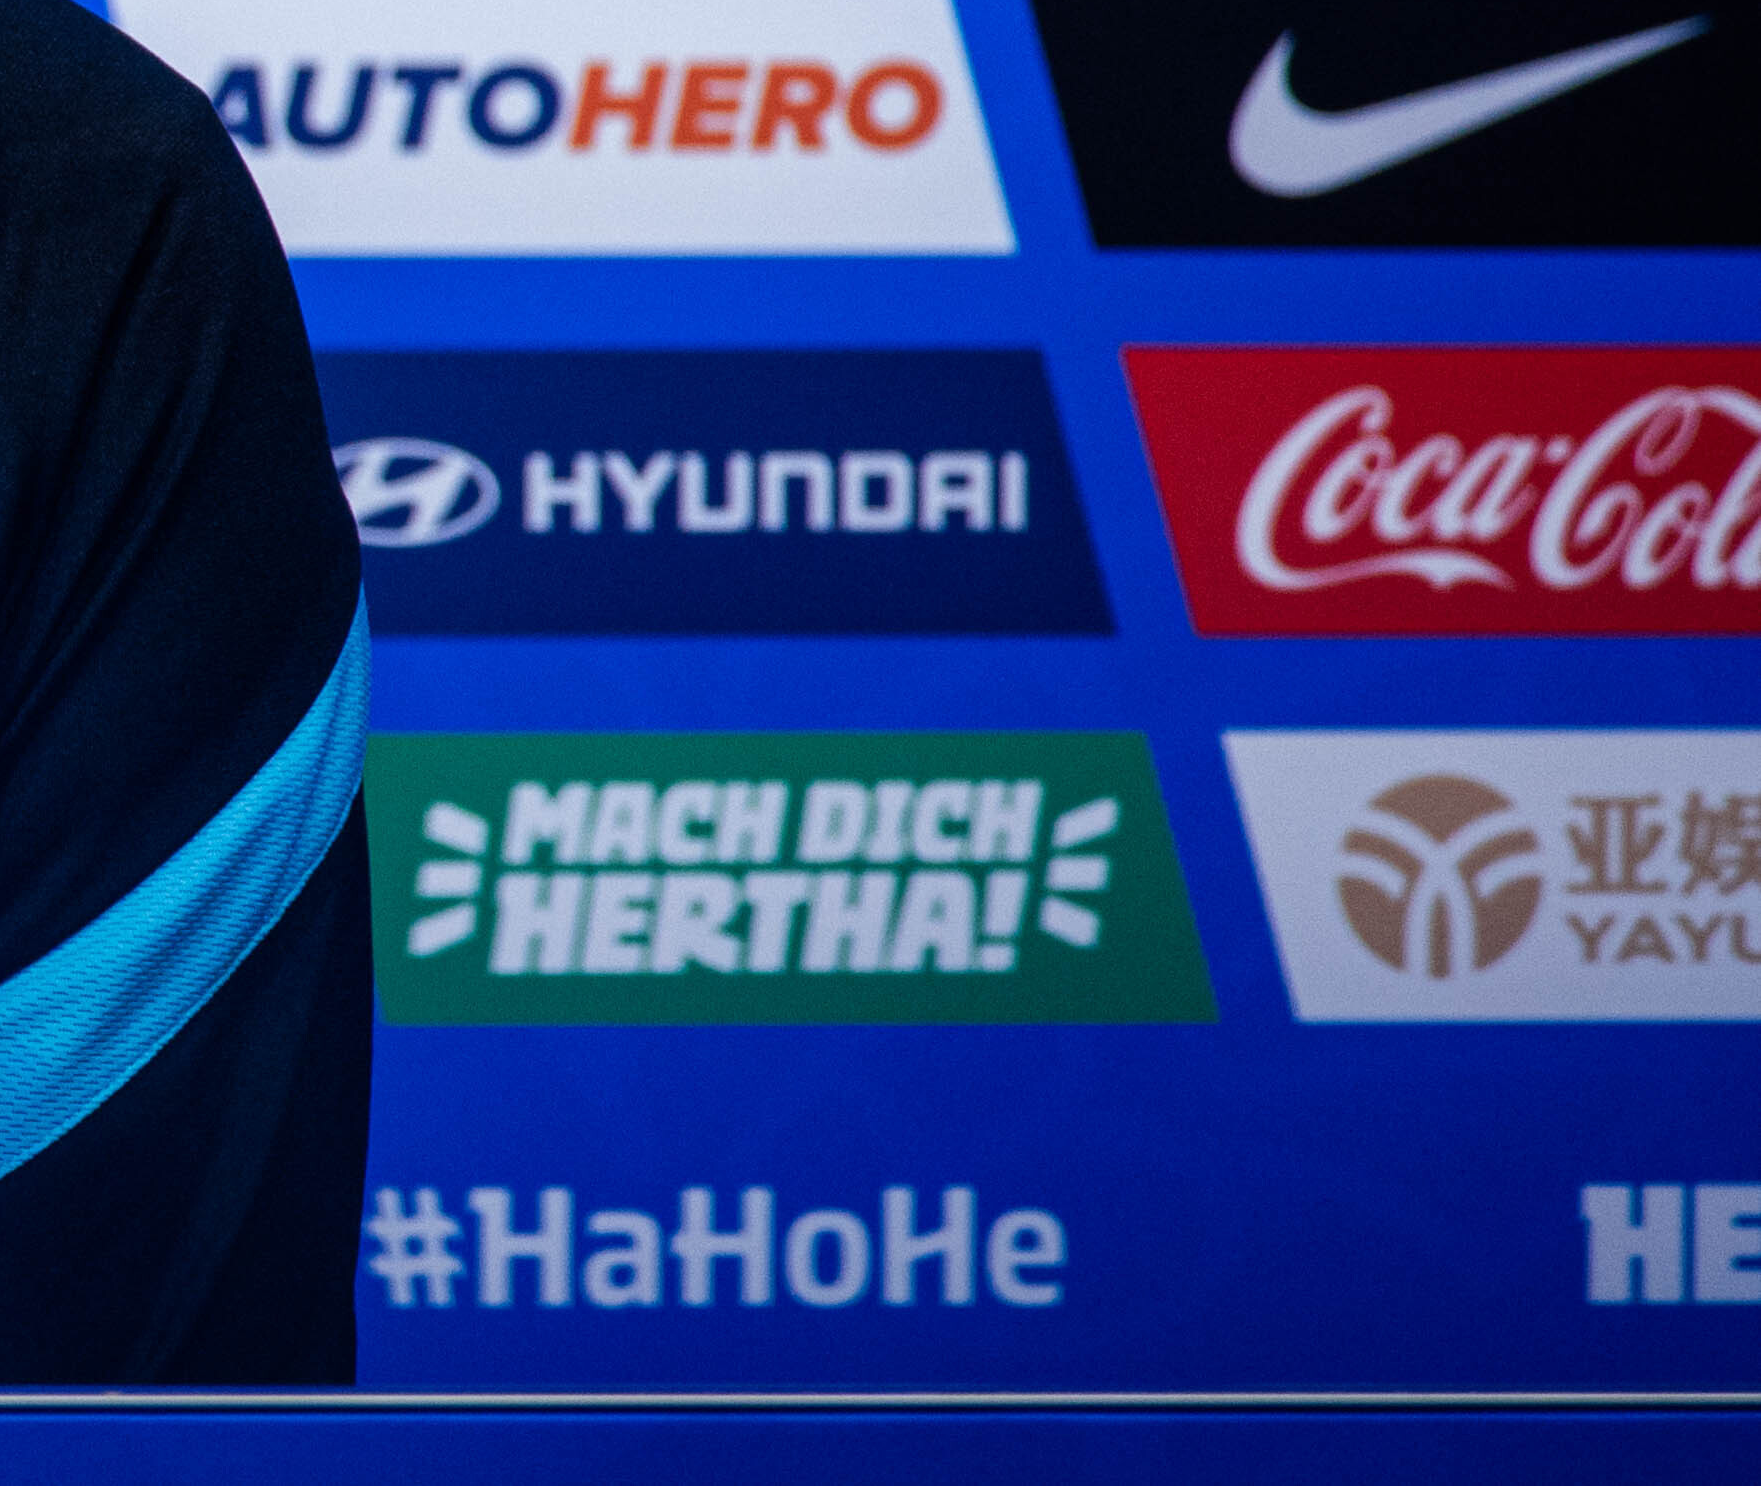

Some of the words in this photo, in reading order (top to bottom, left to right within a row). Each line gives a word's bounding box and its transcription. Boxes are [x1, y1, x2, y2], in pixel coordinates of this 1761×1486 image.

[206, 59, 944, 152] AUTOHERO
[523, 451, 1028, 532] HYUNDAI
[503, 780, 790, 864] MACH
[796, 779, 1042, 864] DICH
[489, 870, 1029, 975] HERTHA!
[367, 1186, 1068, 1307] #HaHoHe
